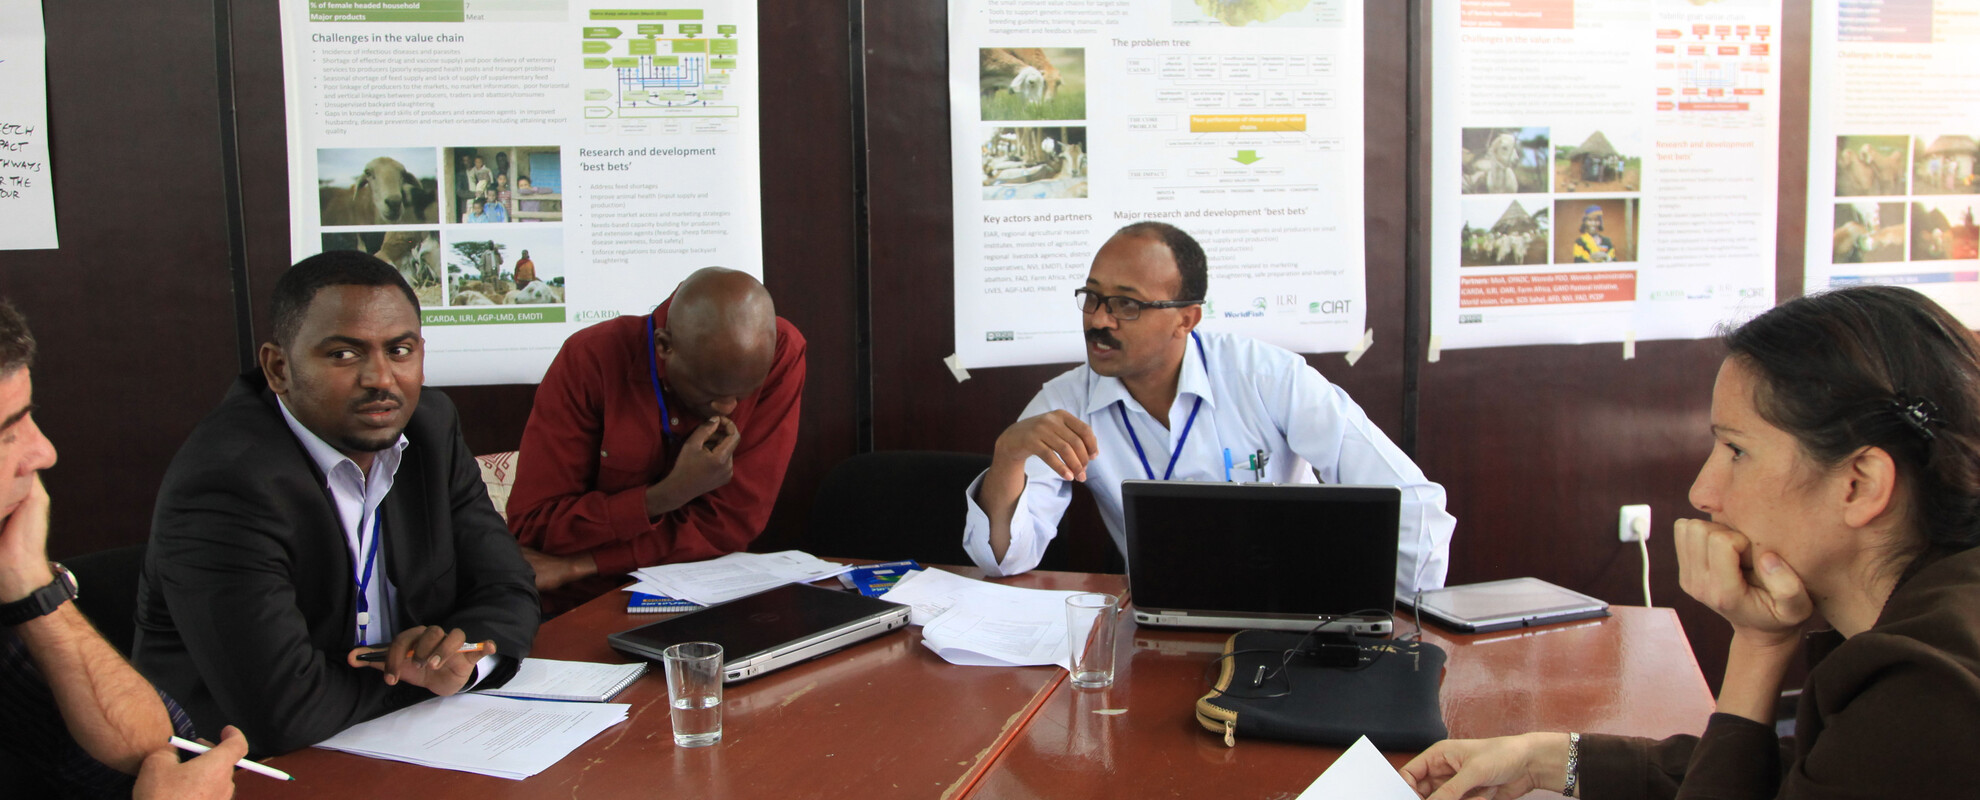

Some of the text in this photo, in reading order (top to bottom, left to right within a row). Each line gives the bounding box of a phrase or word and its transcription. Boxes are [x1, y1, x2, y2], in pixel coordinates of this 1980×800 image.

[310, 13, 366, 22] Major products
[312, 33, 368, 45] Challenges
[384, 33, 402, 42] the
[404, 33, 433, 42] value
[435, 33, 464, 42] chain
[1131, 38, 1170, 49] problem
[1171, 38, 1191, 46] tree
[432, 48, 461, 57] parasites
[351, 74, 379, 82] shortage
[403, 74, 423, 82] supply
[459, 74, 479, 82] supply
[325, 109, 340, 118] Gaps
[348, 109, 382, 117] knowledge
[420, 108, 451, 117] producers
[496, 108, 517, 116] agents
[526, 108, 555, 116] improved
[0, 123, 34, 136] ETCH
[325, 127, 347, 136] quality
[579, 146, 716, 158] Research and development
[9, 176, 31, 188] THE
[629, 183, 658, 191] shortages
[590, 193, 615, 201] Improve
[657, 192, 675, 200] (input
[676, 192, 696, 200] supply
[984, 212, 1092, 225] Key actors and partners
[1113, 209, 1141, 221] Major
[1143, 208, 1181, 218] research
[1183, 208, 1200, 217] and
[1202, 207, 1261, 219] development
[657, 247, 689, 256] discourage
[689, 247, 716, 255] backyard
[1277, 294, 1297, 305] ILRI
[1321, 299, 1352, 314] CIAT
[425, 312, 543, 323] ICARDA, ILRI, AGP-LMD, EMDTI
[582, 309, 621, 318] ICARDA
